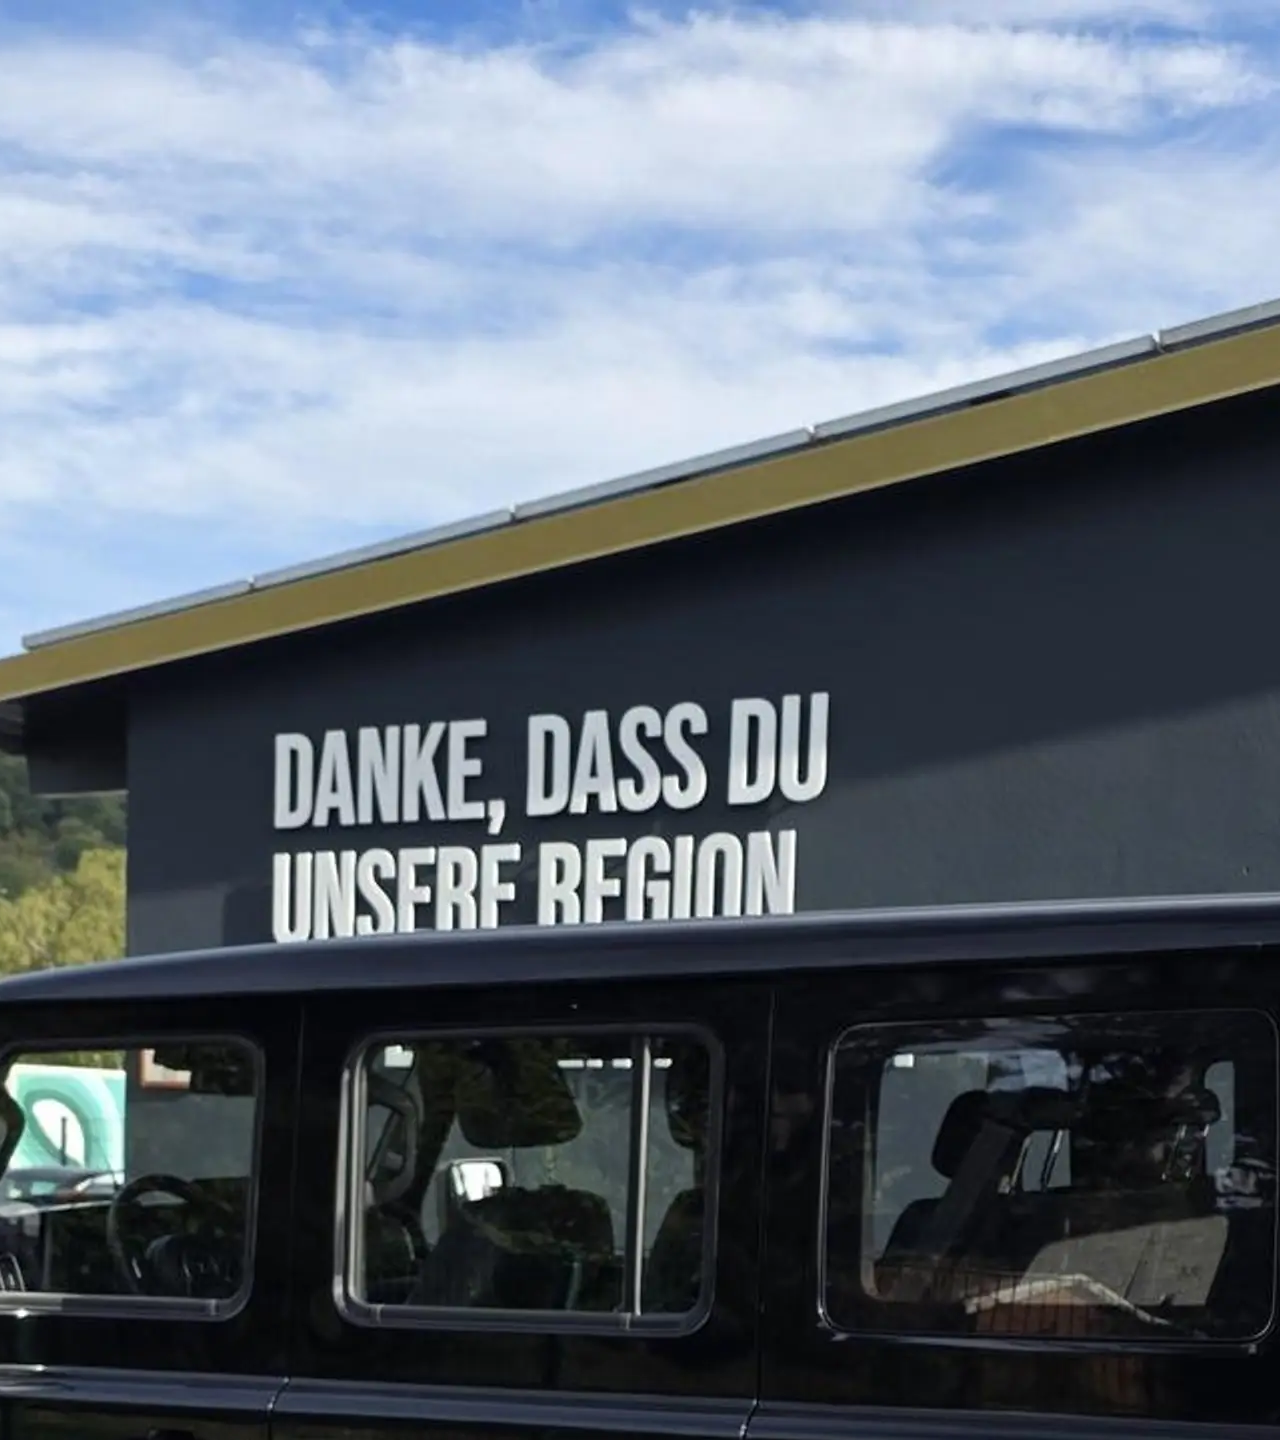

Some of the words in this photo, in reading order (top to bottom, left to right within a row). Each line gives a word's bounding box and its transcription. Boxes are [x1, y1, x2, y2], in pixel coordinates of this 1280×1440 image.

[274, 719, 506, 835] DANKE,
[527, 702, 709, 817] DASS
[728, 692, 830, 806] DU
